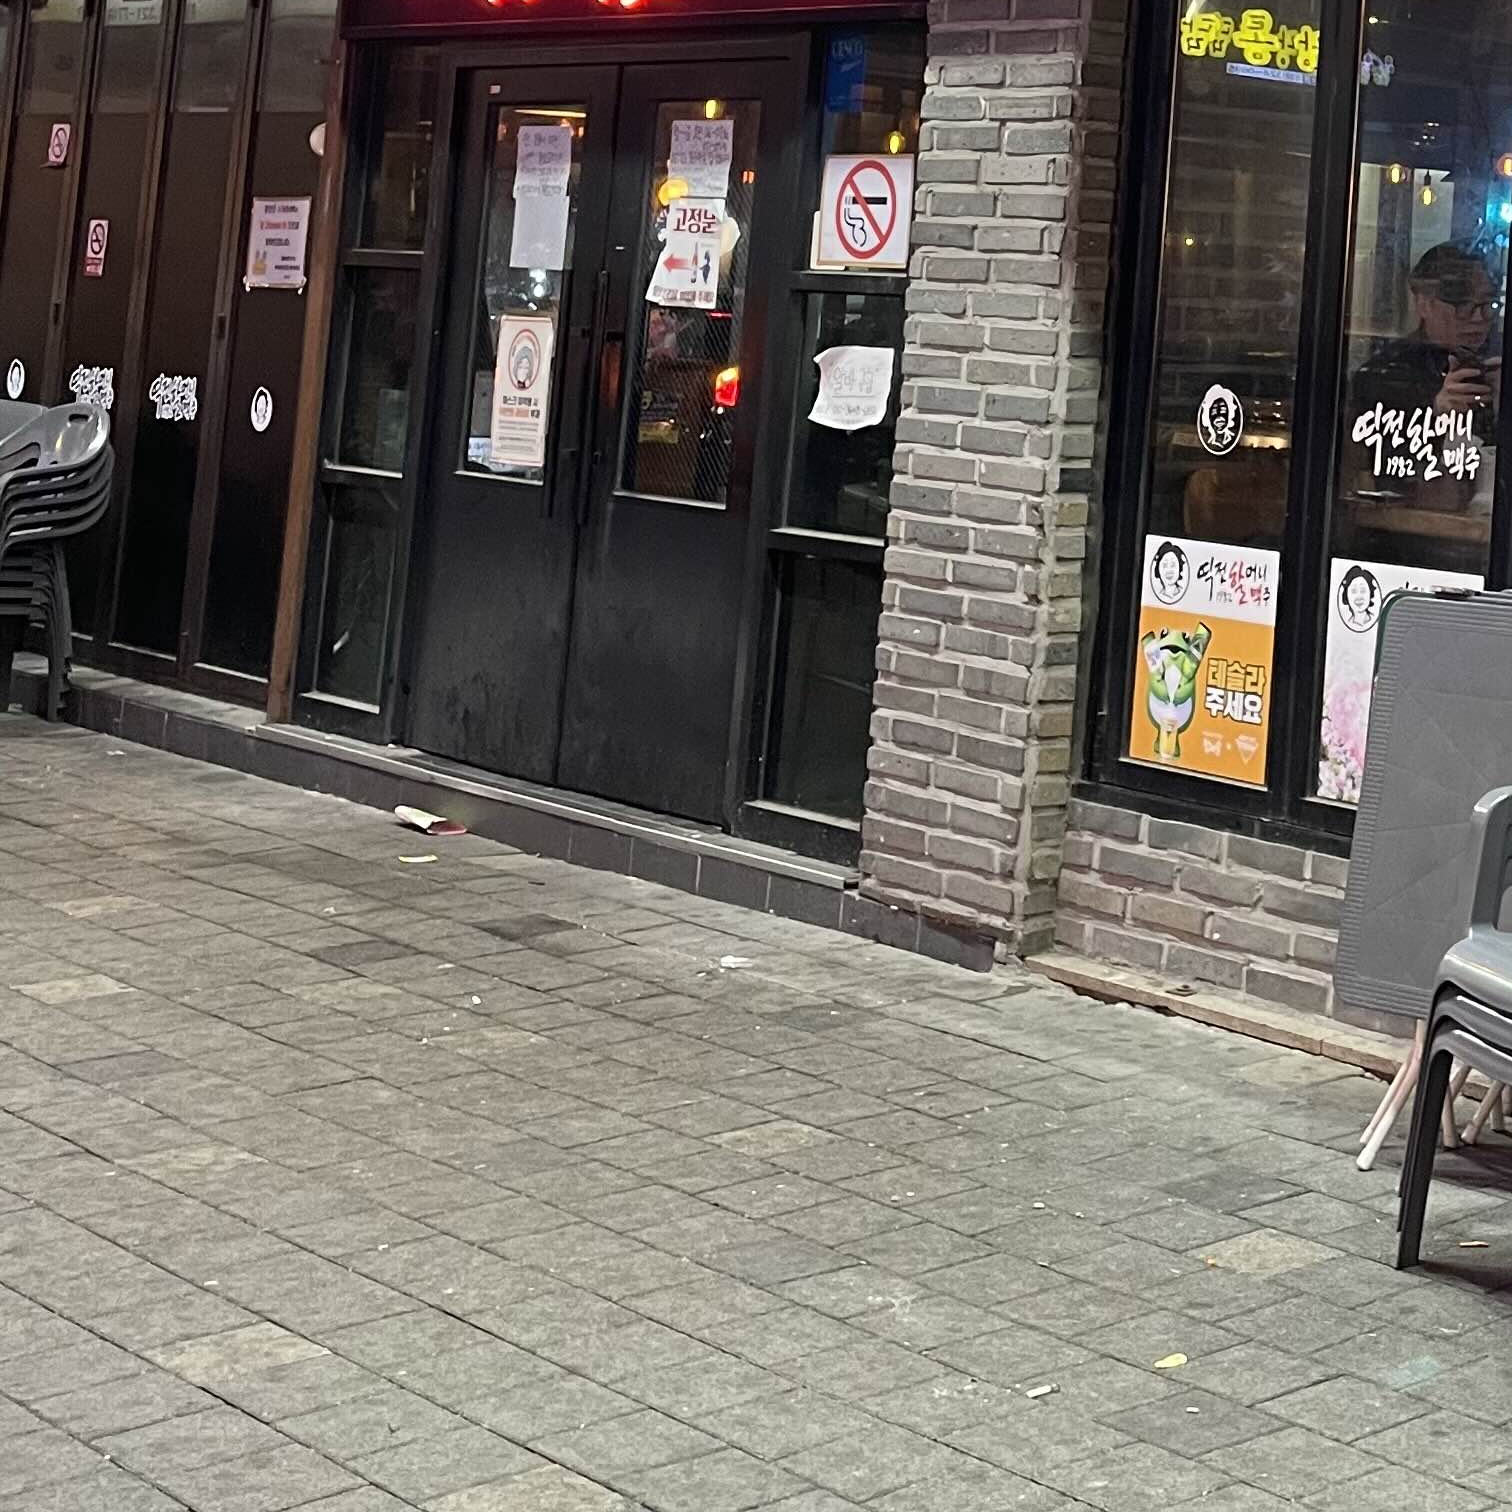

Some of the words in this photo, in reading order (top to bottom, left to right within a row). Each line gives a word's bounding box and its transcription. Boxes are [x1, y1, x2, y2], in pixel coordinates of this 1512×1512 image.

[1442, 442, 1481, 481] 맥주
[1207, 657, 1267, 698] 테슬라
[1204, 686, 1264, 727] 주세요
